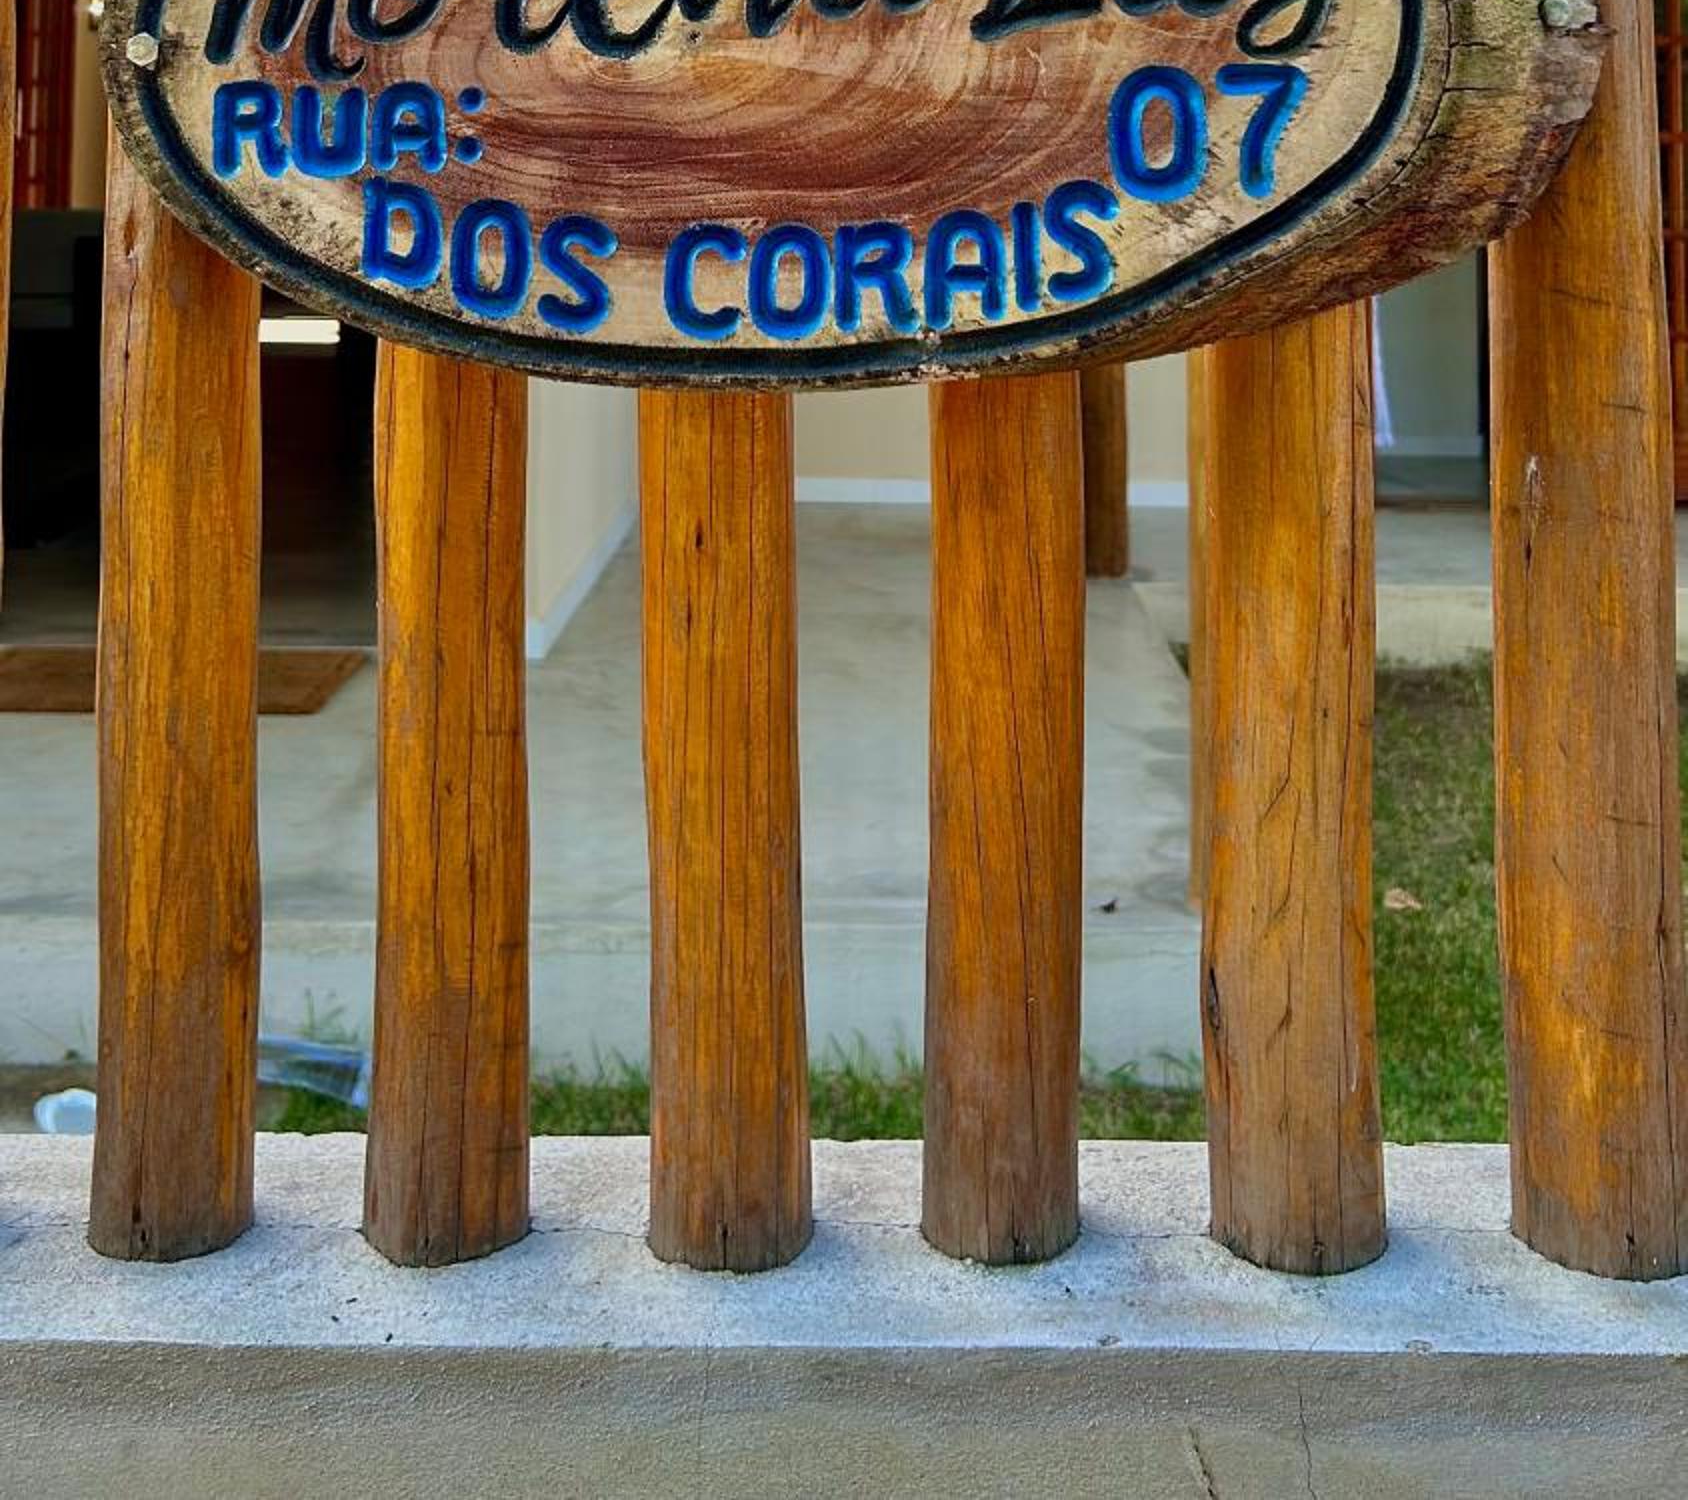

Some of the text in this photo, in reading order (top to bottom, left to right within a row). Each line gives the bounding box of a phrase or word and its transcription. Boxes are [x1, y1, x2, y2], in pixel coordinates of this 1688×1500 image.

[211, 80, 486, 179] RUA:
[361, 62, 1311, 341] DOS CORAIS 07
